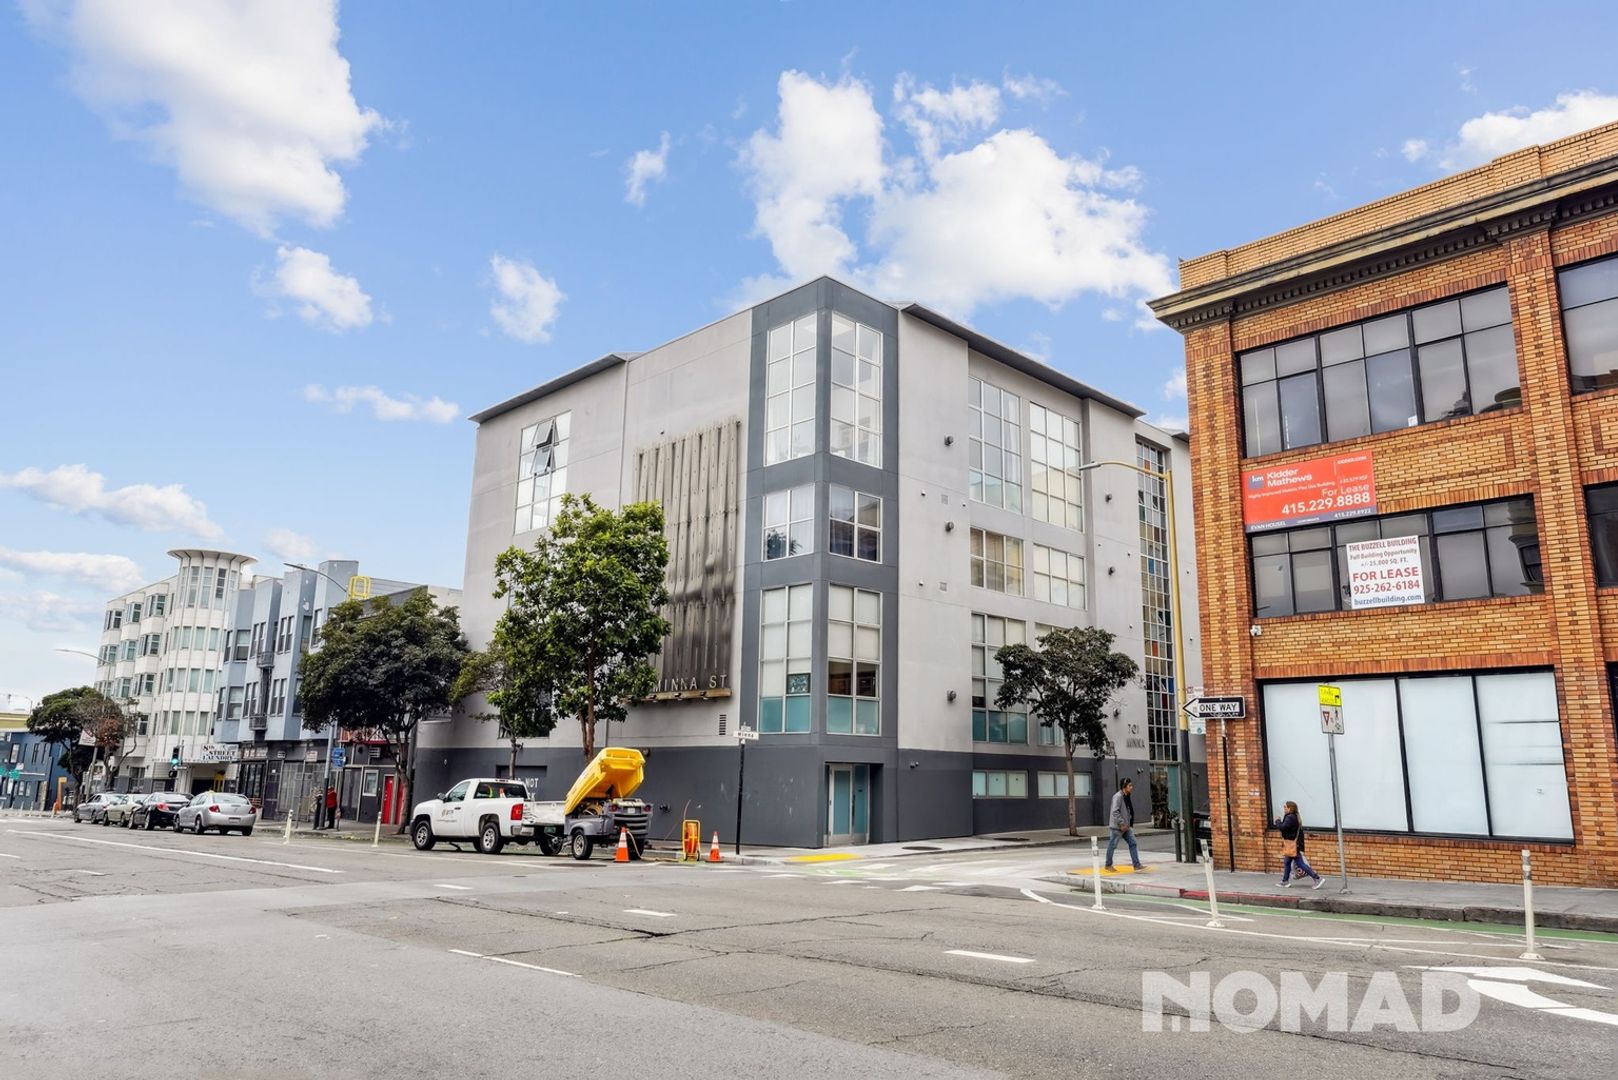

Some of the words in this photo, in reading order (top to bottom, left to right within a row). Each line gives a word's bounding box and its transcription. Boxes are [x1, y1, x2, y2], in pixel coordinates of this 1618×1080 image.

[1266, 468, 1298, 480] Kidder
[1267, 474, 1312, 488] Mathews
[1322, 488, 1338, 498] For
[1340, 484, 1370, 495] Lease
[1282, 492, 1370, 515] 415.229.8888
[1348, 544, 1360, 552] THE
[1360, 542, 1386, 550] BUZZELL
[1386, 538, 1417, 548] BUILDING
[1360, 552, 1383, 560] Building
[1384, 548, 1417, 558] Opportunity
[1352, 570, 1377, 582] FOR
[1380, 566, 1419, 580] LEASE
[1354, 580, 1420, 595] 925-262-6184
[1354, 594, 1422, 606] buzzellbuilding.com
[653, 677, 698, 692] MINNA
[709, 674, 727, 688] ST
[1200, 704, 1216, 712] ONE
[1219, 704, 1237, 712] WAY
[526, 778, 539, 788] NOT
